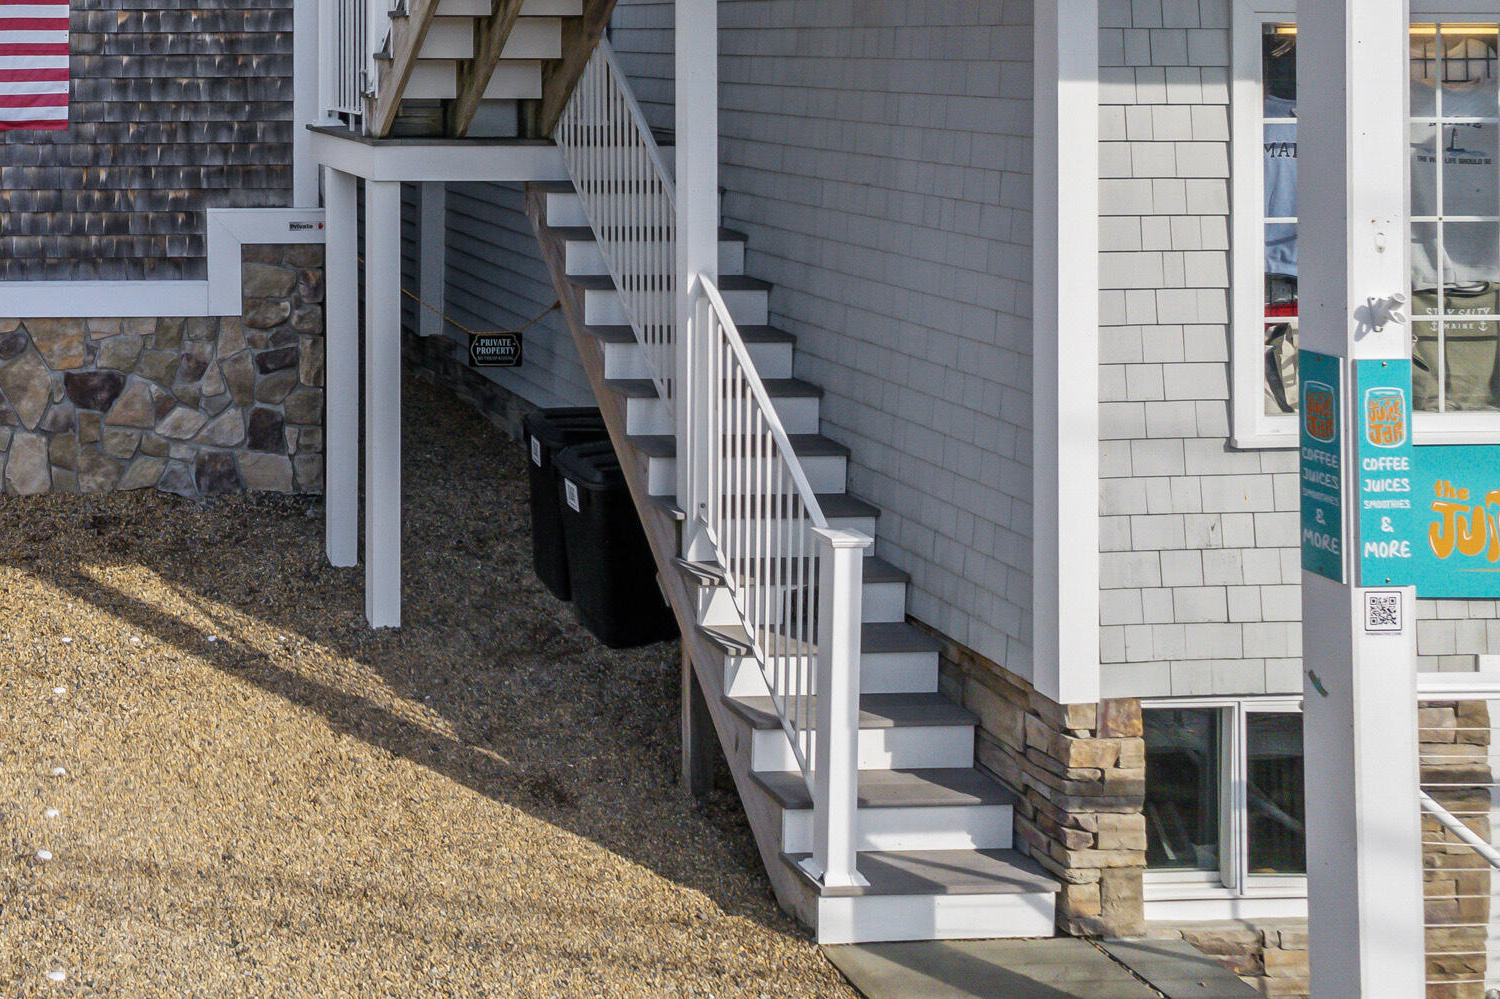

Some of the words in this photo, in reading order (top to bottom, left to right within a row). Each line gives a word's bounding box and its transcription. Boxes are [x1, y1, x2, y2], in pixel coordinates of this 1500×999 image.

[1426, 307, 1455, 316] STY
[476, 347, 515, 355] PROPERTY
[1302, 446, 1339, 468] COFFEE
[1363, 456, 1410, 471] COFFEE
[1302, 467, 1339, 490] JUICES
[1363, 478, 1411, 492] JUICES
[1433, 479, 1470, 500] the
[1363, 499, 1411, 509] SMOOTHIES
[1316, 508, 1326, 525] &
[1380, 516, 1394, 532] &
[1303, 527, 1340, 555] MORE
[1364, 540, 1412, 558] MORE
